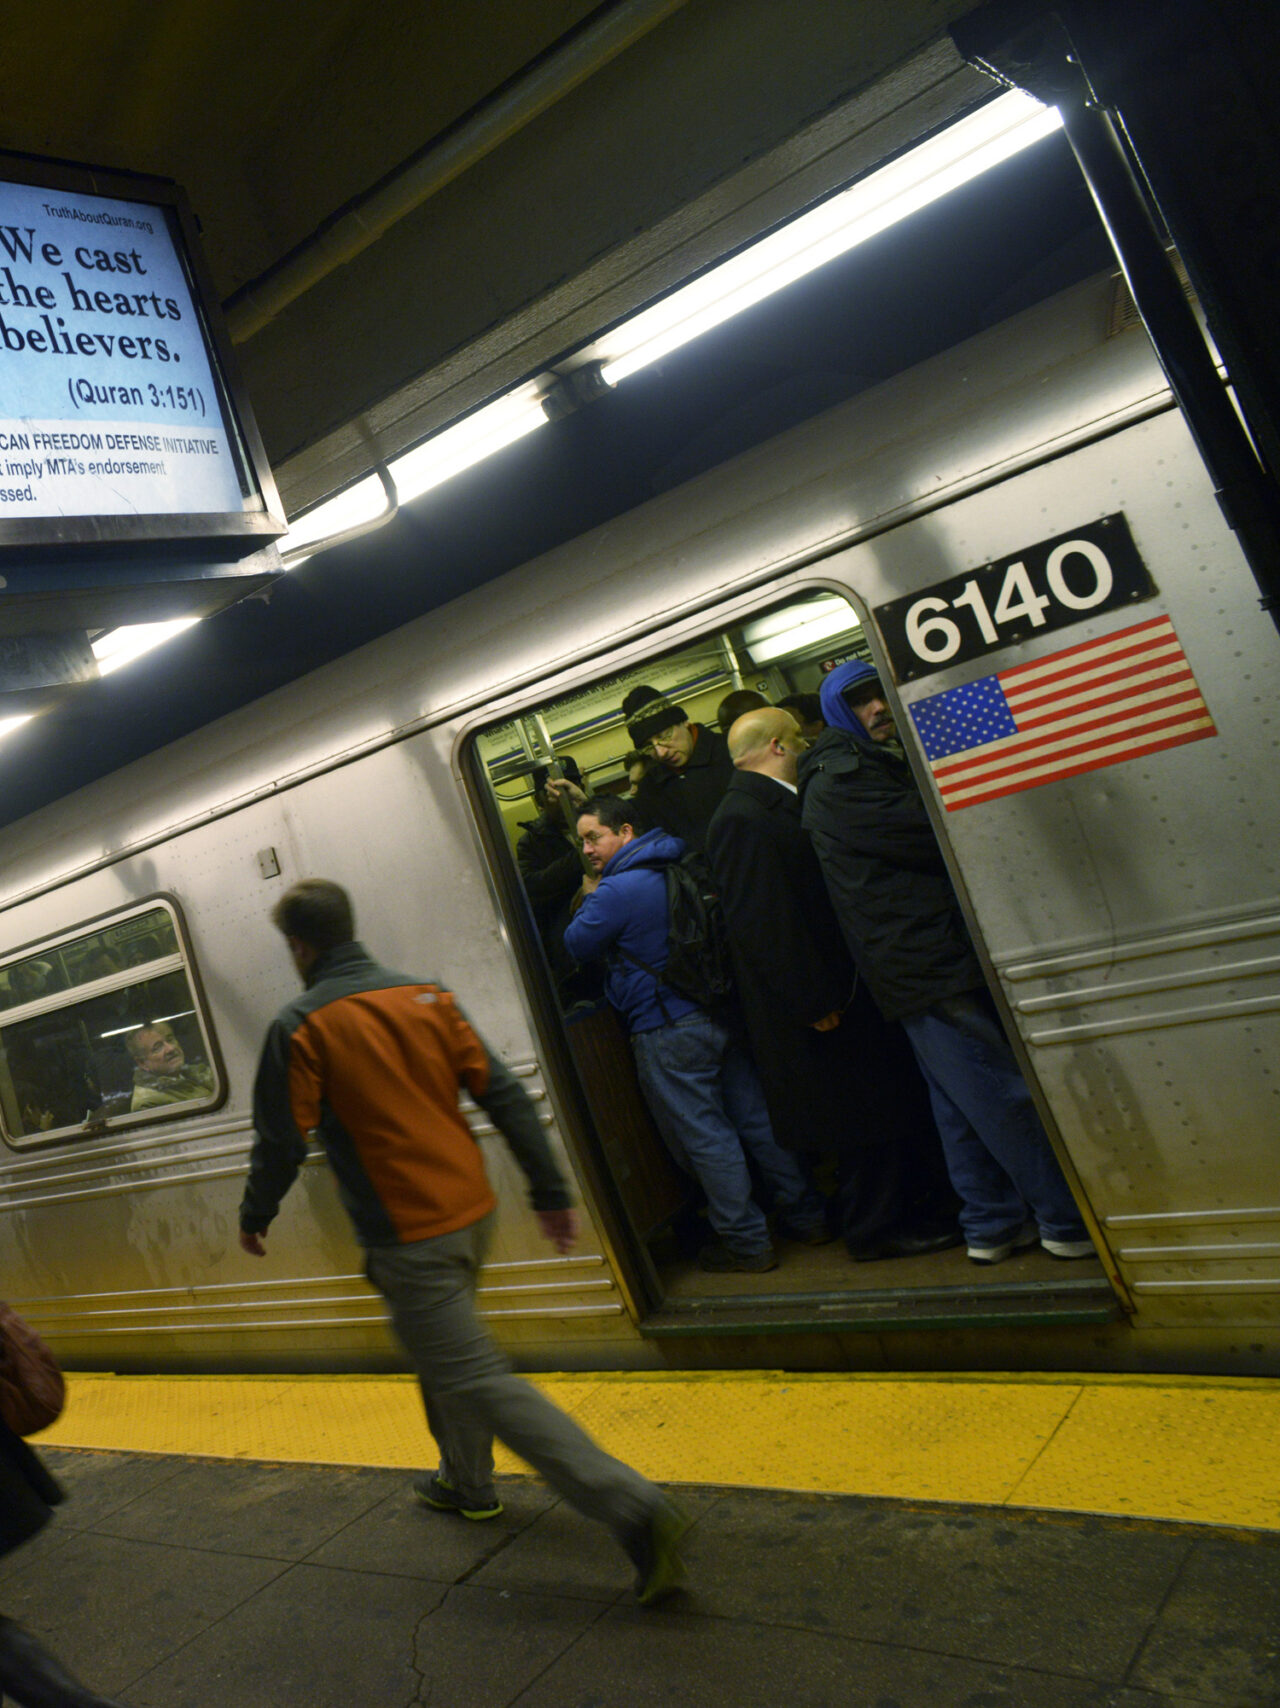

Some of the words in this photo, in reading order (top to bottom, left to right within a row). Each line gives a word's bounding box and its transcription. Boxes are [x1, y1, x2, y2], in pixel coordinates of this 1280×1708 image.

[42, 204, 154, 235] TruthAboutQuran.org
[75, 247, 147, 275] cast
[61, 272, 182, 321] hearts
[68, 378, 144, 409] (Quran
[147, 383, 207, 418] 3:151)
[32, 433, 104, 451] FREEDOM
[104, 434, 162, 452] DEFENSE
[162, 436, 220, 454] INITIATIVE
[6, 458, 43, 479] imply
[46, 457, 86, 476] MTA's
[88, 459, 167, 477] endorsement
[904, 539, 1114, 664] 6140
